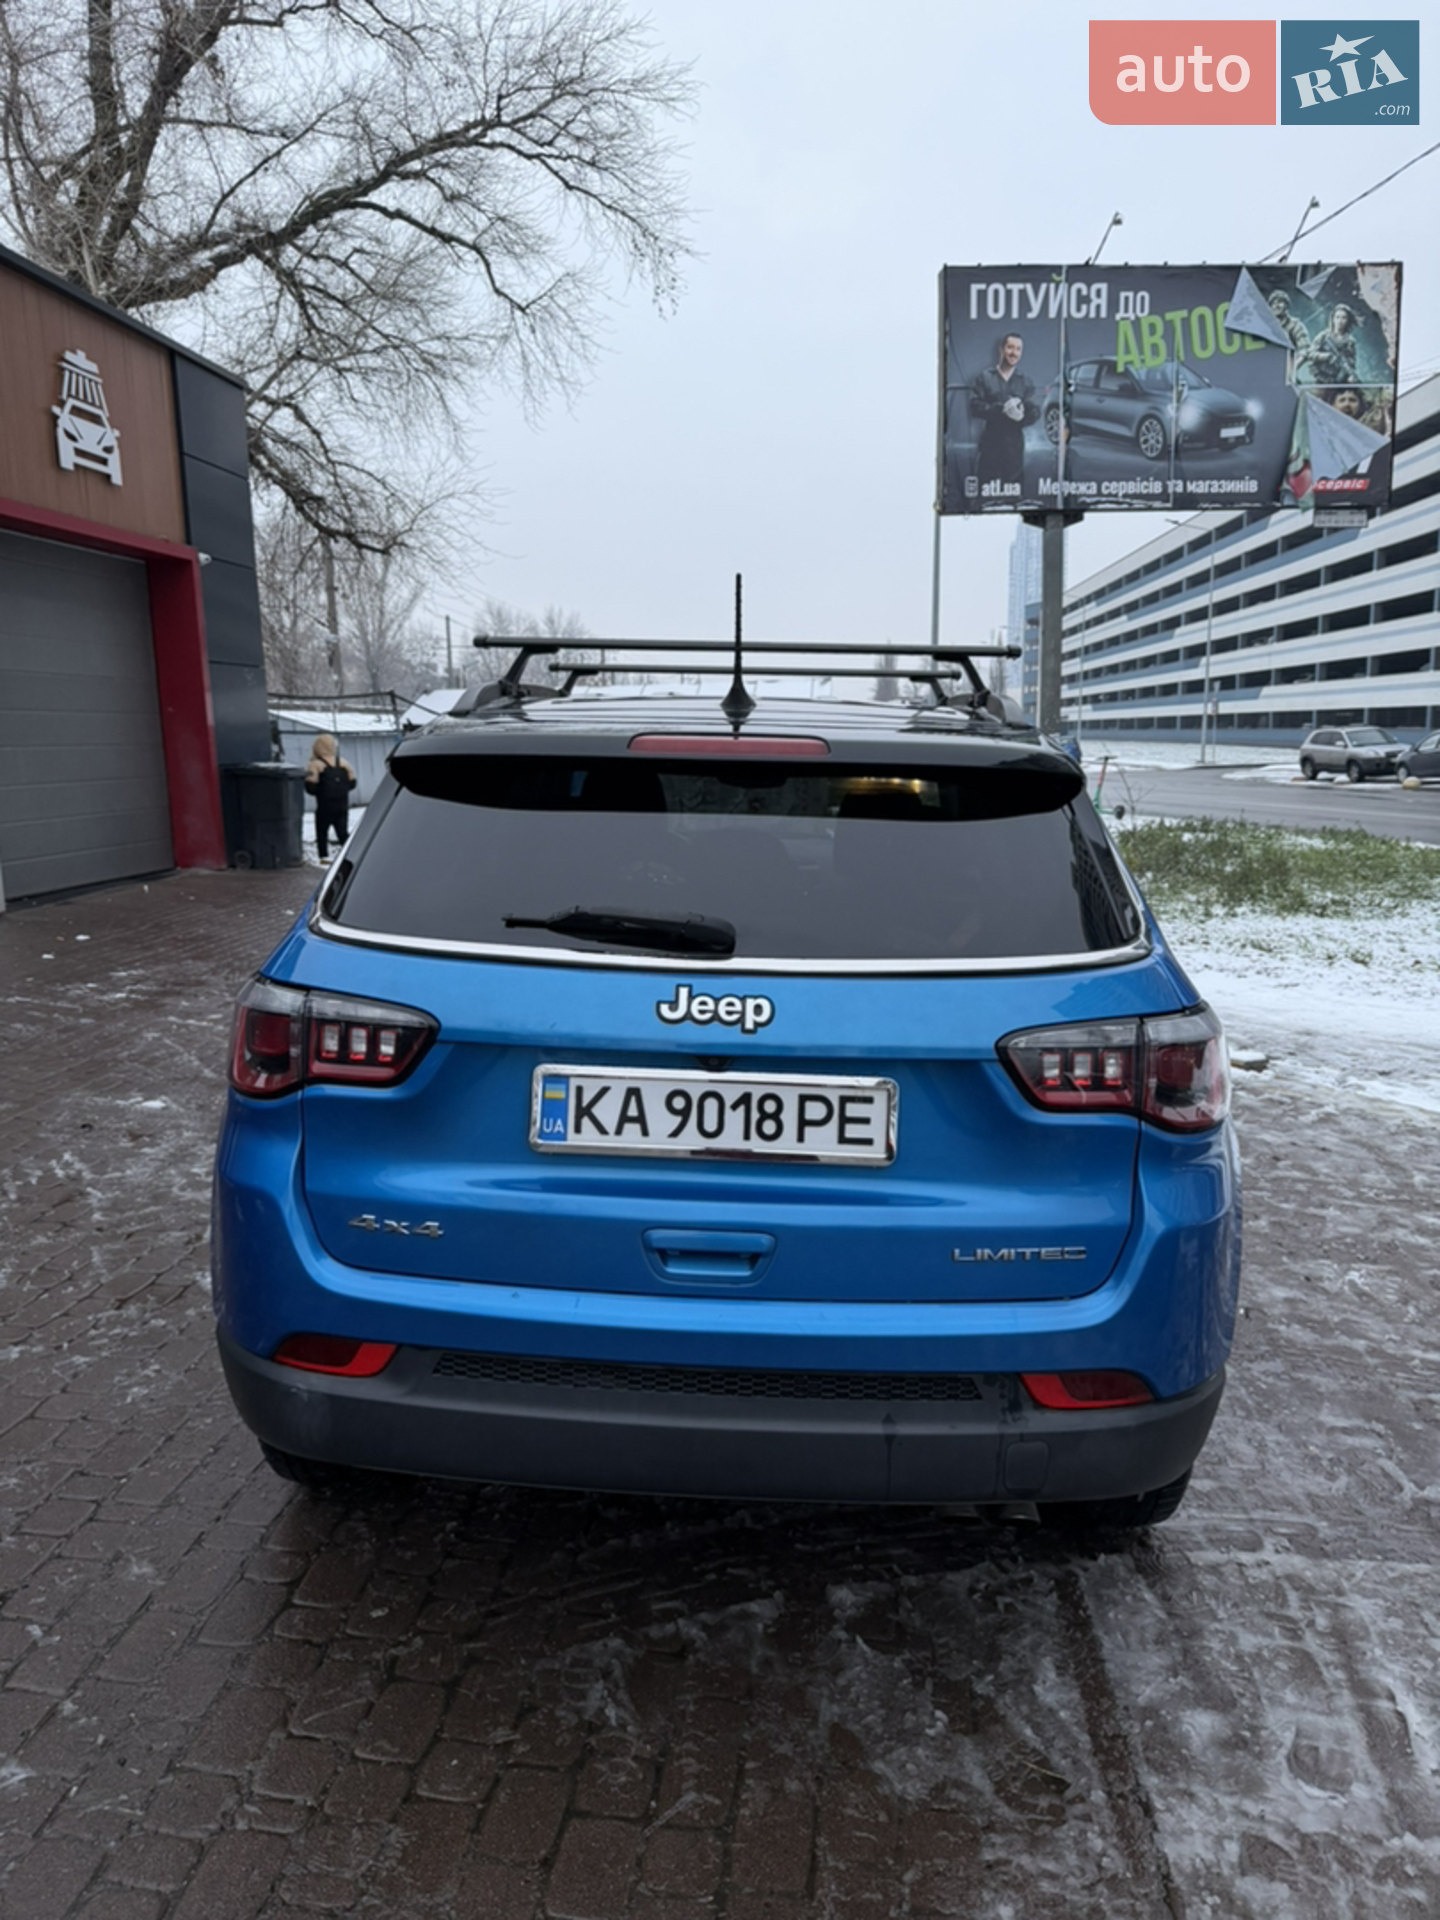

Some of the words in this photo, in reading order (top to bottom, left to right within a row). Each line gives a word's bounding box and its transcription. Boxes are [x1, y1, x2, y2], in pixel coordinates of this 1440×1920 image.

[970, 273, 1108, 320] ГОТУЙСЯ
[1116, 302, 1267, 374] АВТОС
[1038, 477, 1098, 497] Мережа
[1101, 477, 1163, 498] сервісів
[1186, 476, 1259, 494] магазинів
[656, 984, 775, 1034] Jeep
[542, 1118, 565, 1134] UA
[573, 1085, 650, 1138] KA
[664, 1089, 785, 1143] 9018
[796, 1094, 875, 1146] PE
[348, 1213, 444, 1239] 4x4
